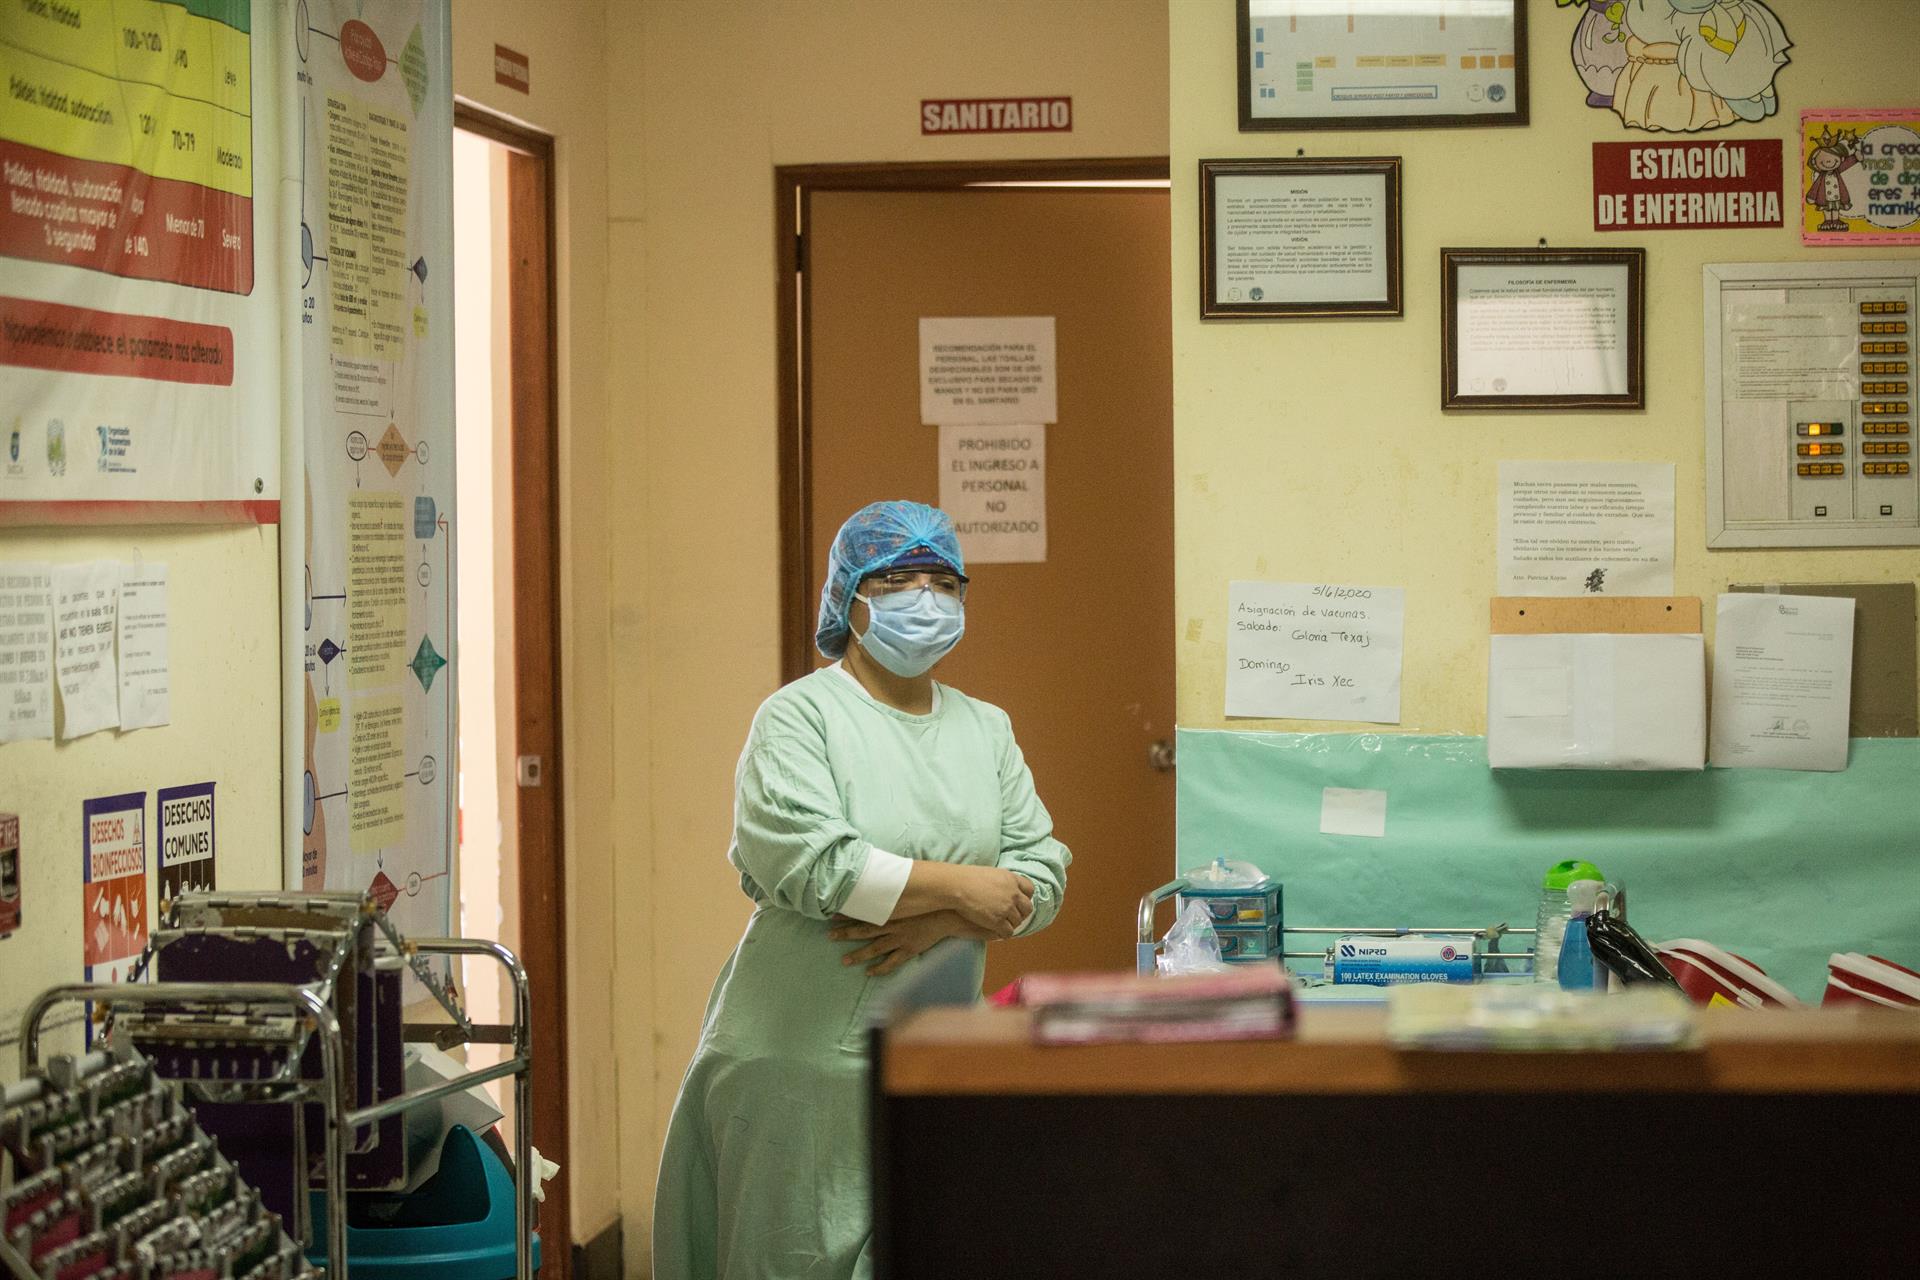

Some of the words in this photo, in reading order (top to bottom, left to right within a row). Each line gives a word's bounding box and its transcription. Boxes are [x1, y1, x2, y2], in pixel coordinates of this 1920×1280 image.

[923, 101, 1069, 131] SANITARIO
[1629, 142, 1746, 180] ESTACIÓN
[1870, 170, 1889, 185] de
[1868, 187, 1903, 200] eres
[1598, 194, 1628, 225] DE
[1633, 191, 1781, 224] ENFERMERIA
[959, 439, 1031, 451] PROHIBIDO
[951, 460, 964, 472] EL
[968, 459, 1027, 472] INGRESO
[1029, 460, 1039, 471] A
[961, 480, 1028, 492] PERSONAL
[985, 501, 1007, 513] NO
[955, 521, 1039, 534] AUTORIZADO
[1302, 605, 1316, 616] de
[1330, 630, 1372, 648] Texaj
[1238, 658, 1290, 674] Domingo
[1290, 674, 1325, 686] Iris
[1333, 675, 1355, 687] Xec
[164, 799, 211, 827] DESECHOS
[92, 818, 124, 844] DESECHOS
[164, 831, 209, 860] COMUNES
[92, 846, 142, 878] BIOINFECCIOSOS
[1358, 948, 1387, 956] NIPRO
[1341, 972, 1352, 980] 100
[1353, 972, 1374, 980] LATEX
[1375, 972, 1420, 980] EXAMINATION
[1421, 972, 1448, 980] GLOVES
